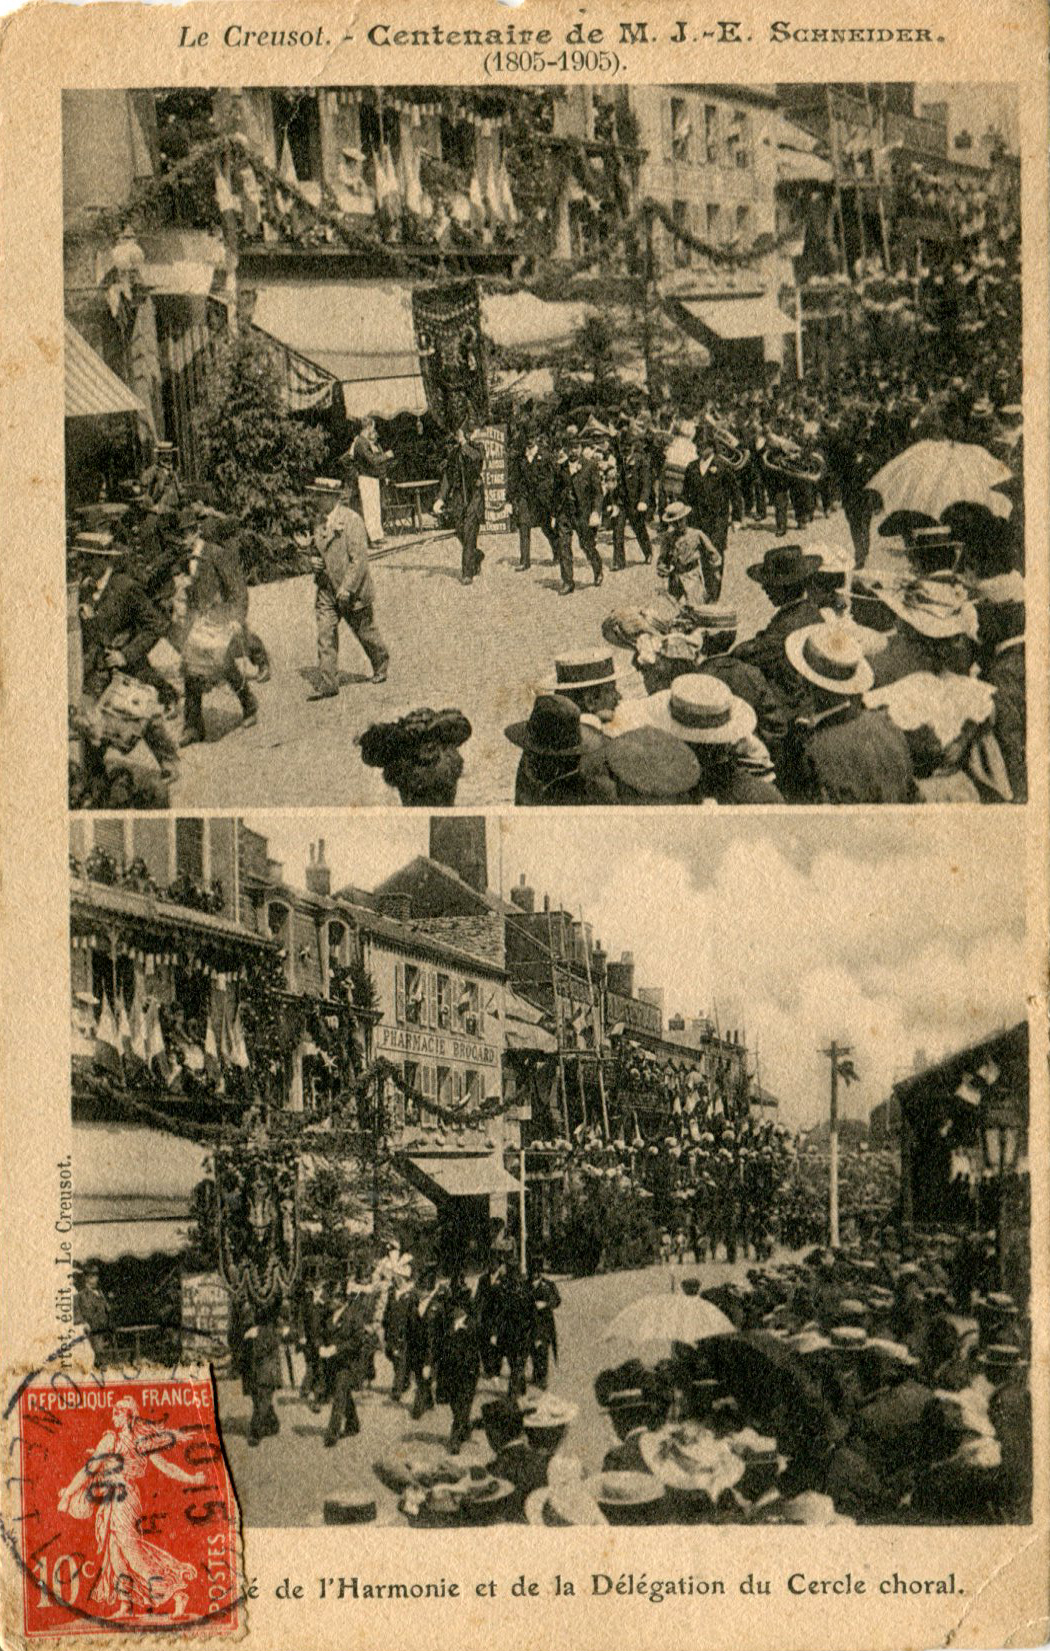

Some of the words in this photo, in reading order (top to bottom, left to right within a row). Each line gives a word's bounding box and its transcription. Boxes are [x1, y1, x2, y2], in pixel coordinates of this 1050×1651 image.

[382, 1028, 446, 1056] PHARMACIE
[453, 1040, 495, 1062] BROCARD
[207, 1532, 228, 1615] POSTES
